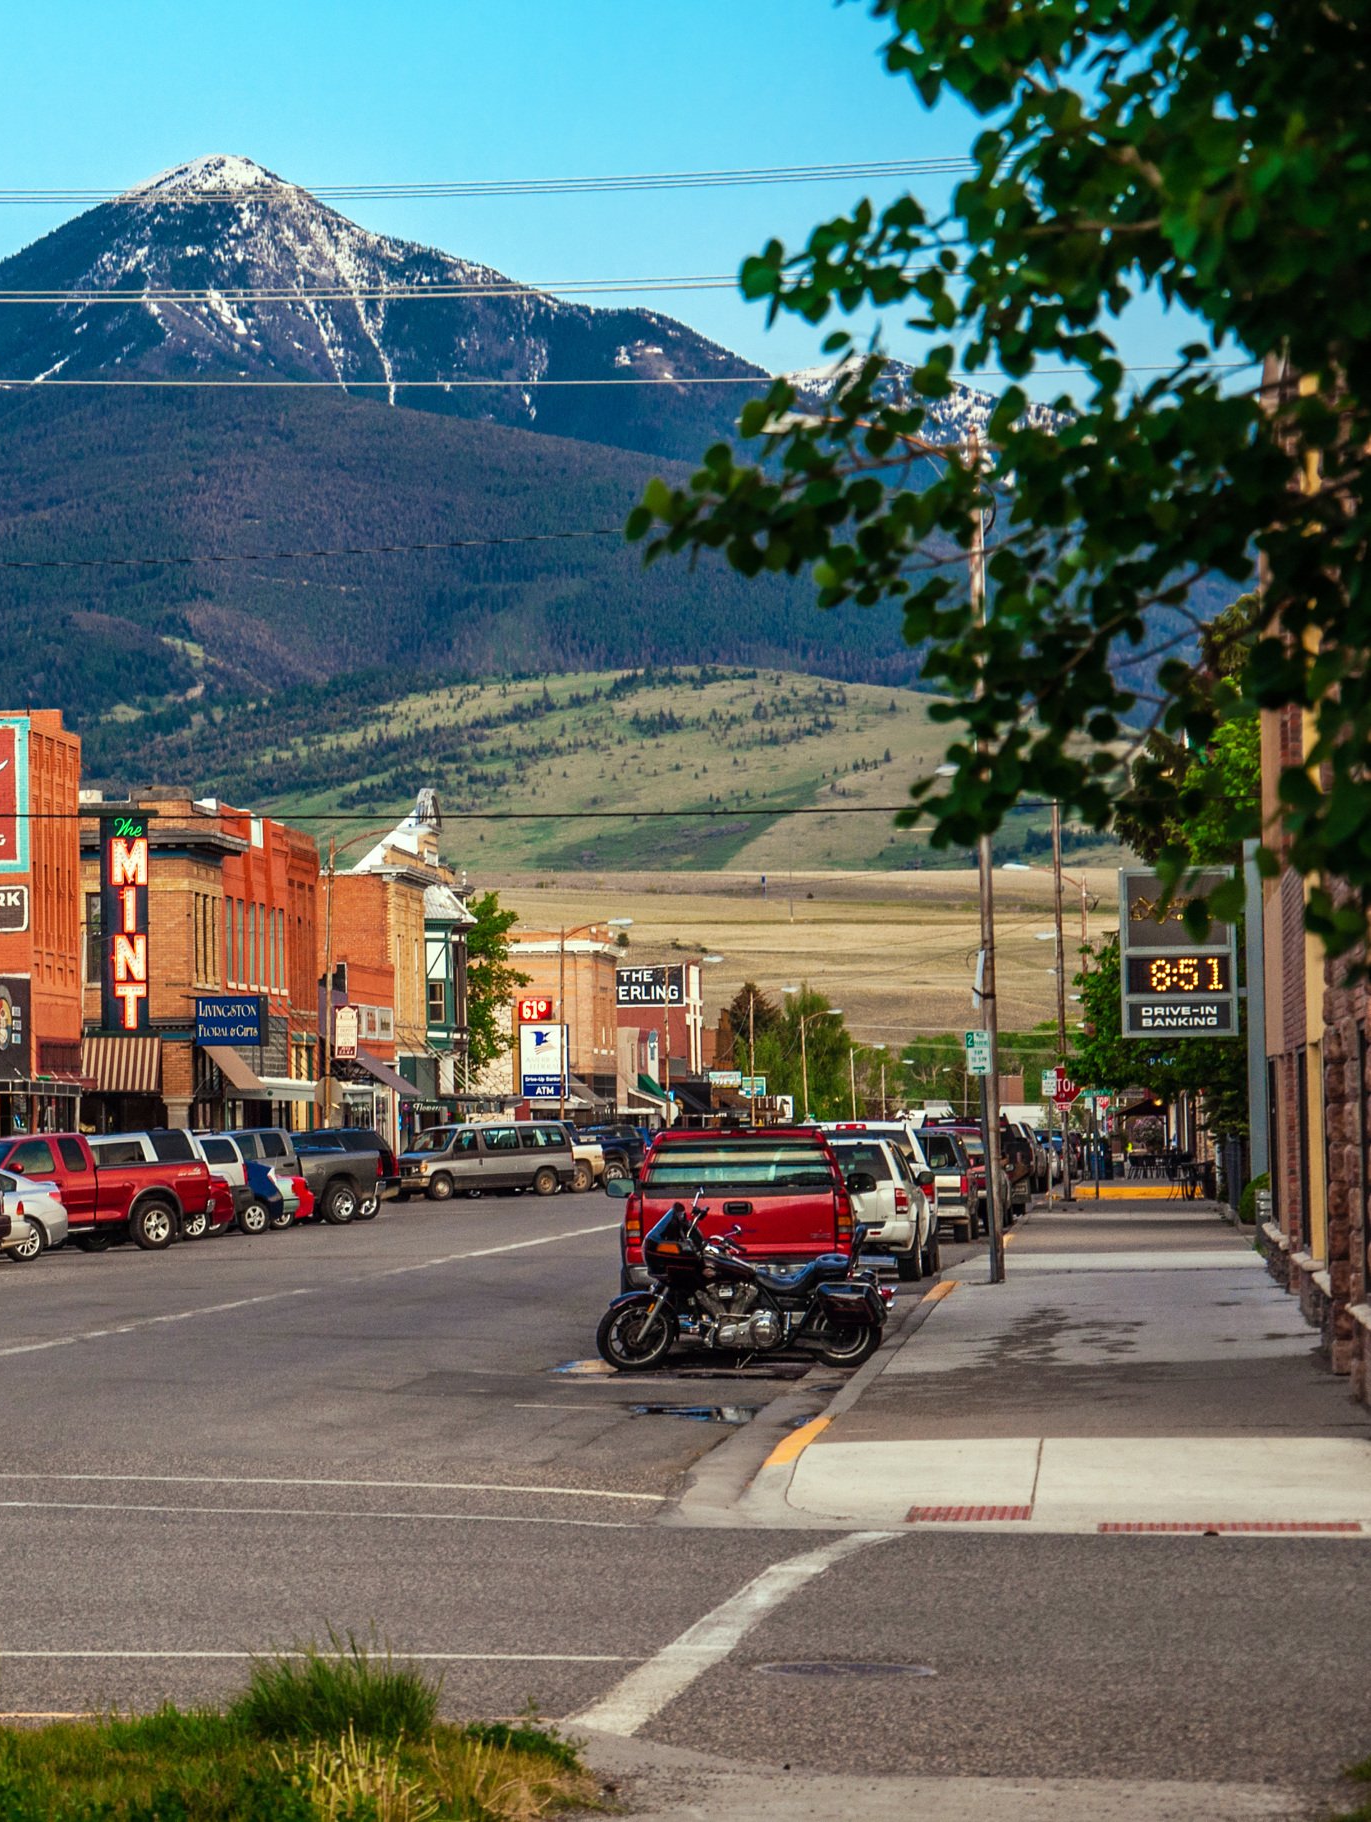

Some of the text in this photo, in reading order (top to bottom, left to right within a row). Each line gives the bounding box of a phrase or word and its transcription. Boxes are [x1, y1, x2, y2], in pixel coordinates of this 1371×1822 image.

[115, 817, 143, 837] The
[110, 838, 148, 1030] MINT
[620, 970, 654, 982] THE
[1150, 958, 1224, 992] 8:51
[616, 985, 679, 1000] ERLING
[198, 1000, 258, 1018] LIVINGSTON
[1141, 1005, 1218, 1016] DRIVE-IN
[1141, 1016, 1218, 1027] BANKING
[535, 1086, 555, 1096] ATM
[1056, 1079, 1075, 1092] TOP
